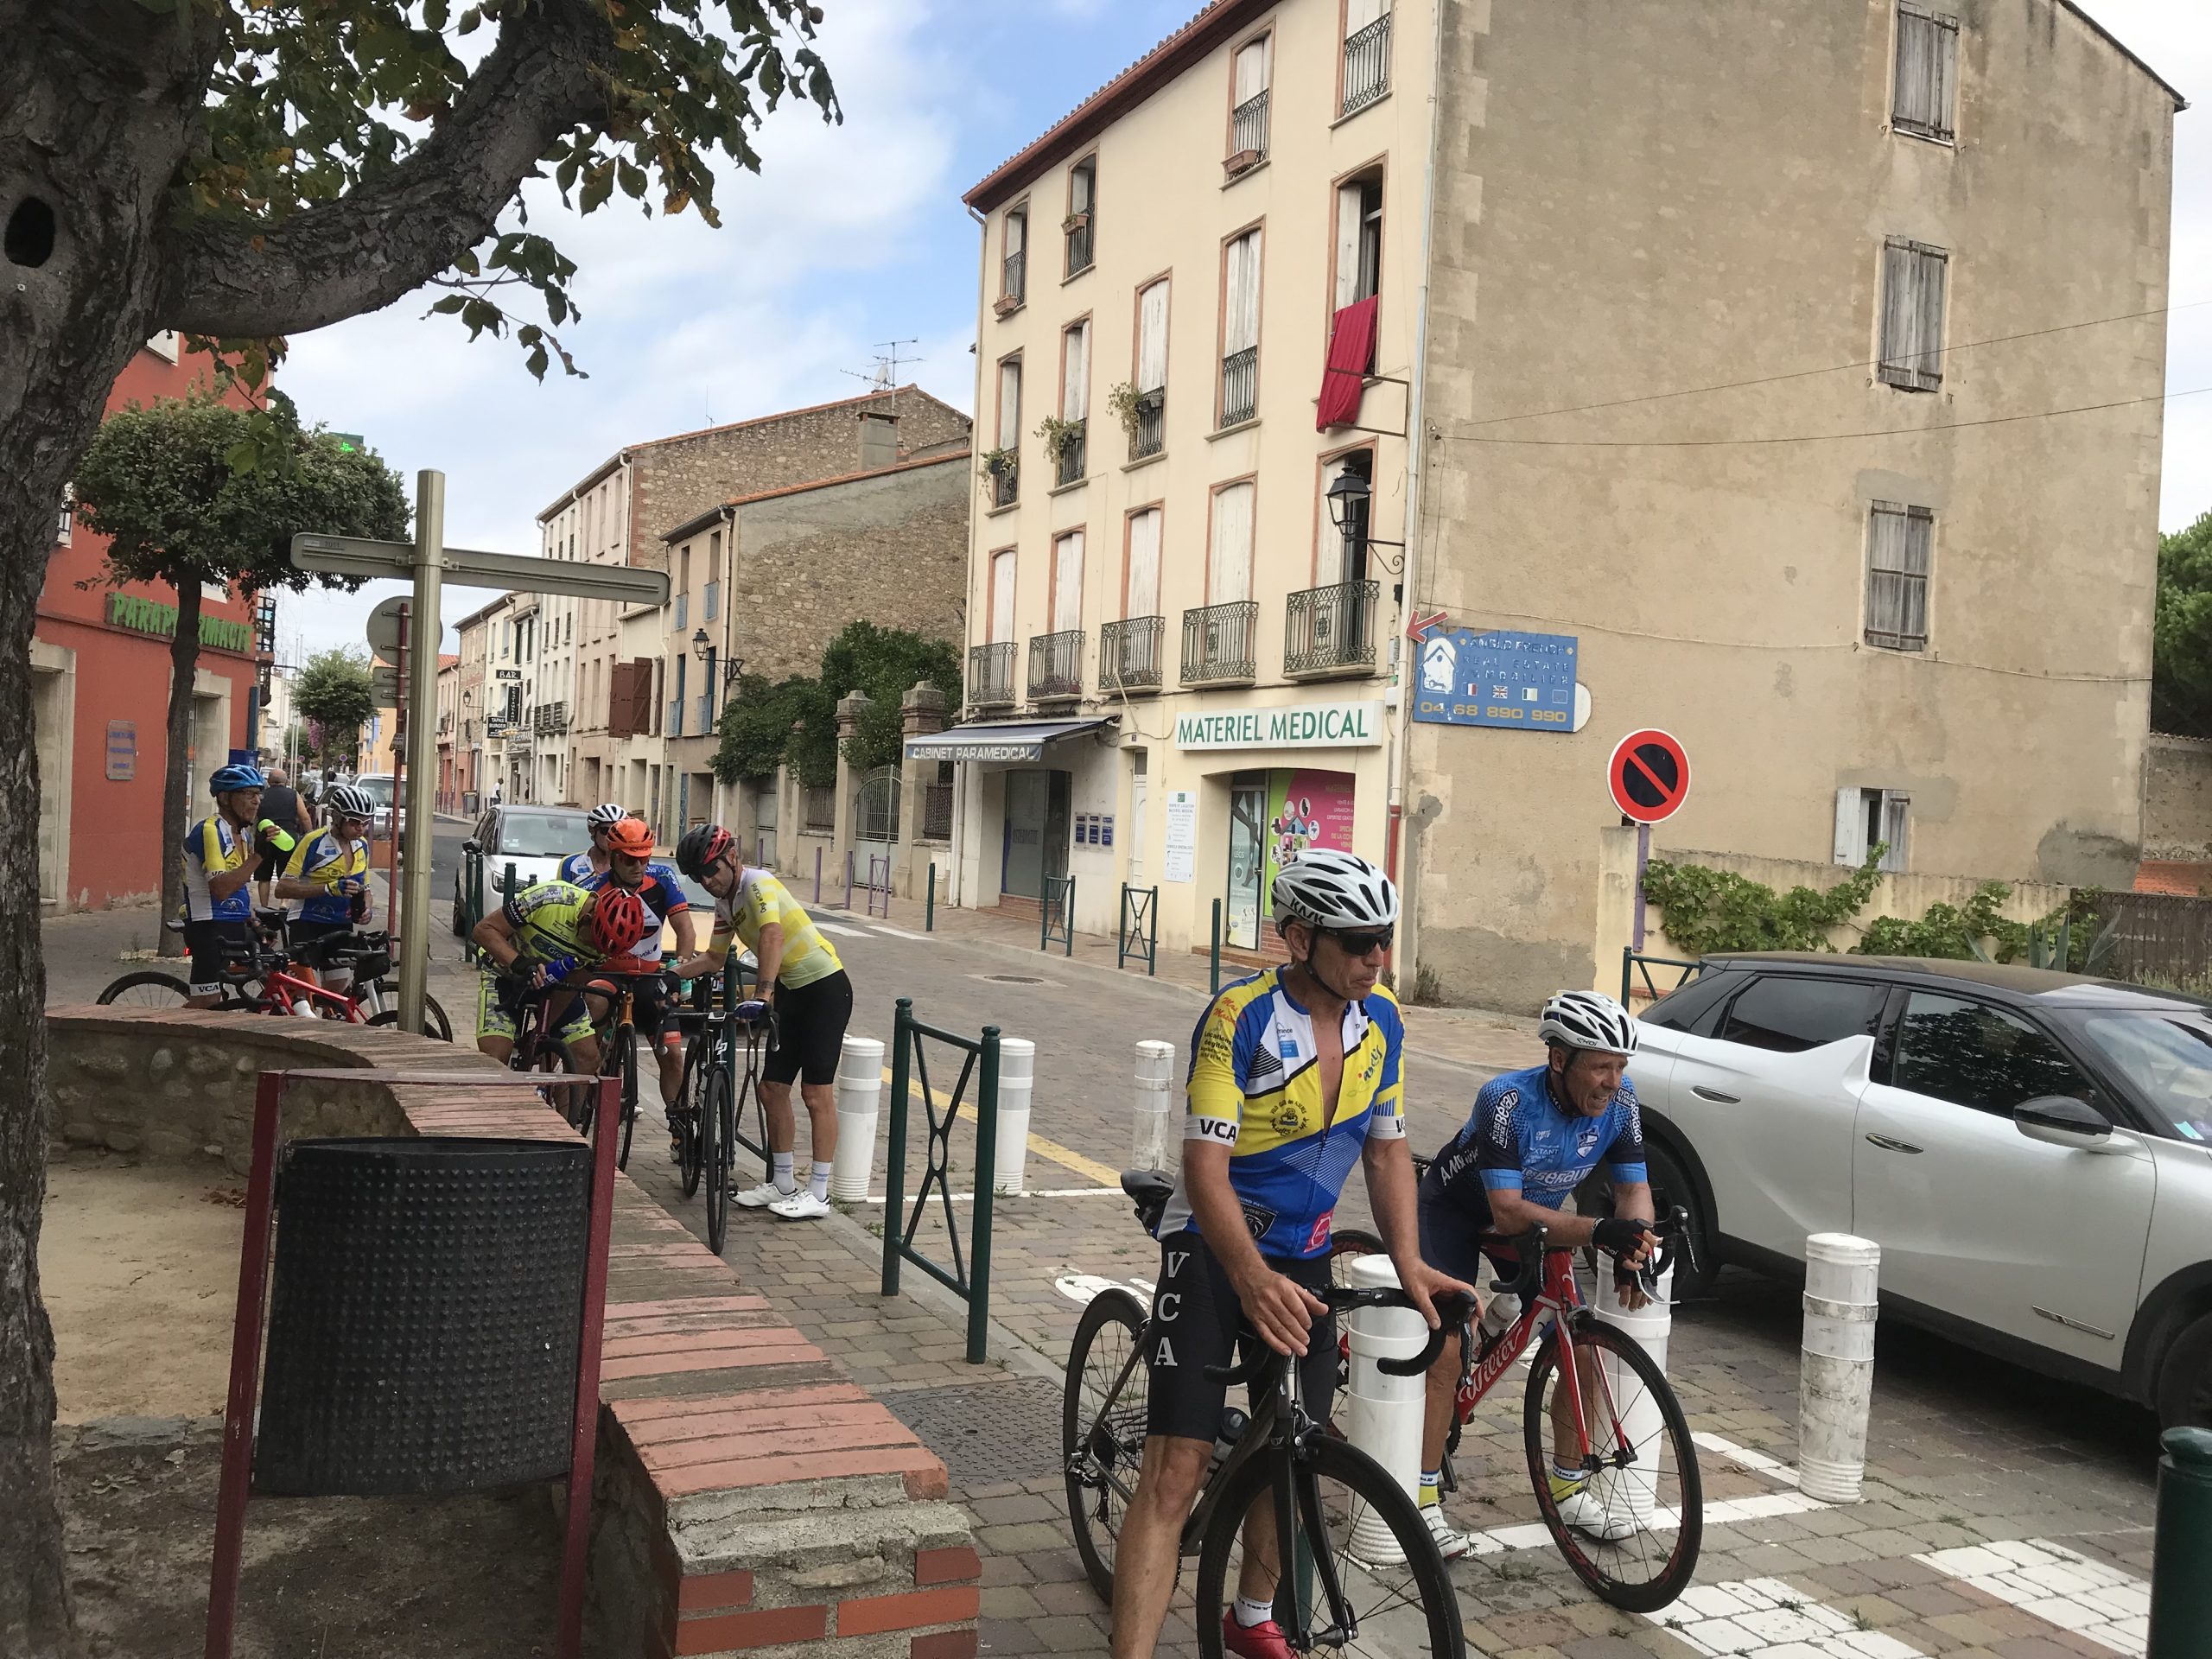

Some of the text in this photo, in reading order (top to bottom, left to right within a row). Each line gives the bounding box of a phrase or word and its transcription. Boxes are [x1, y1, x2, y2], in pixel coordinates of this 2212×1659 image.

[113, 592, 253, 652] PARAPRMACIE
[499, 671, 518, 679] BAR
[1421, 702, 1567, 722] 04 68 890 990
[1179, 709, 1368, 743] MATERIEL MEDICAL
[912, 747, 1035, 760] CABINET PARAMEDICAL
[1200, 1119, 1236, 1141] VCA
[1458, 1325, 1523, 1402] Wilier
